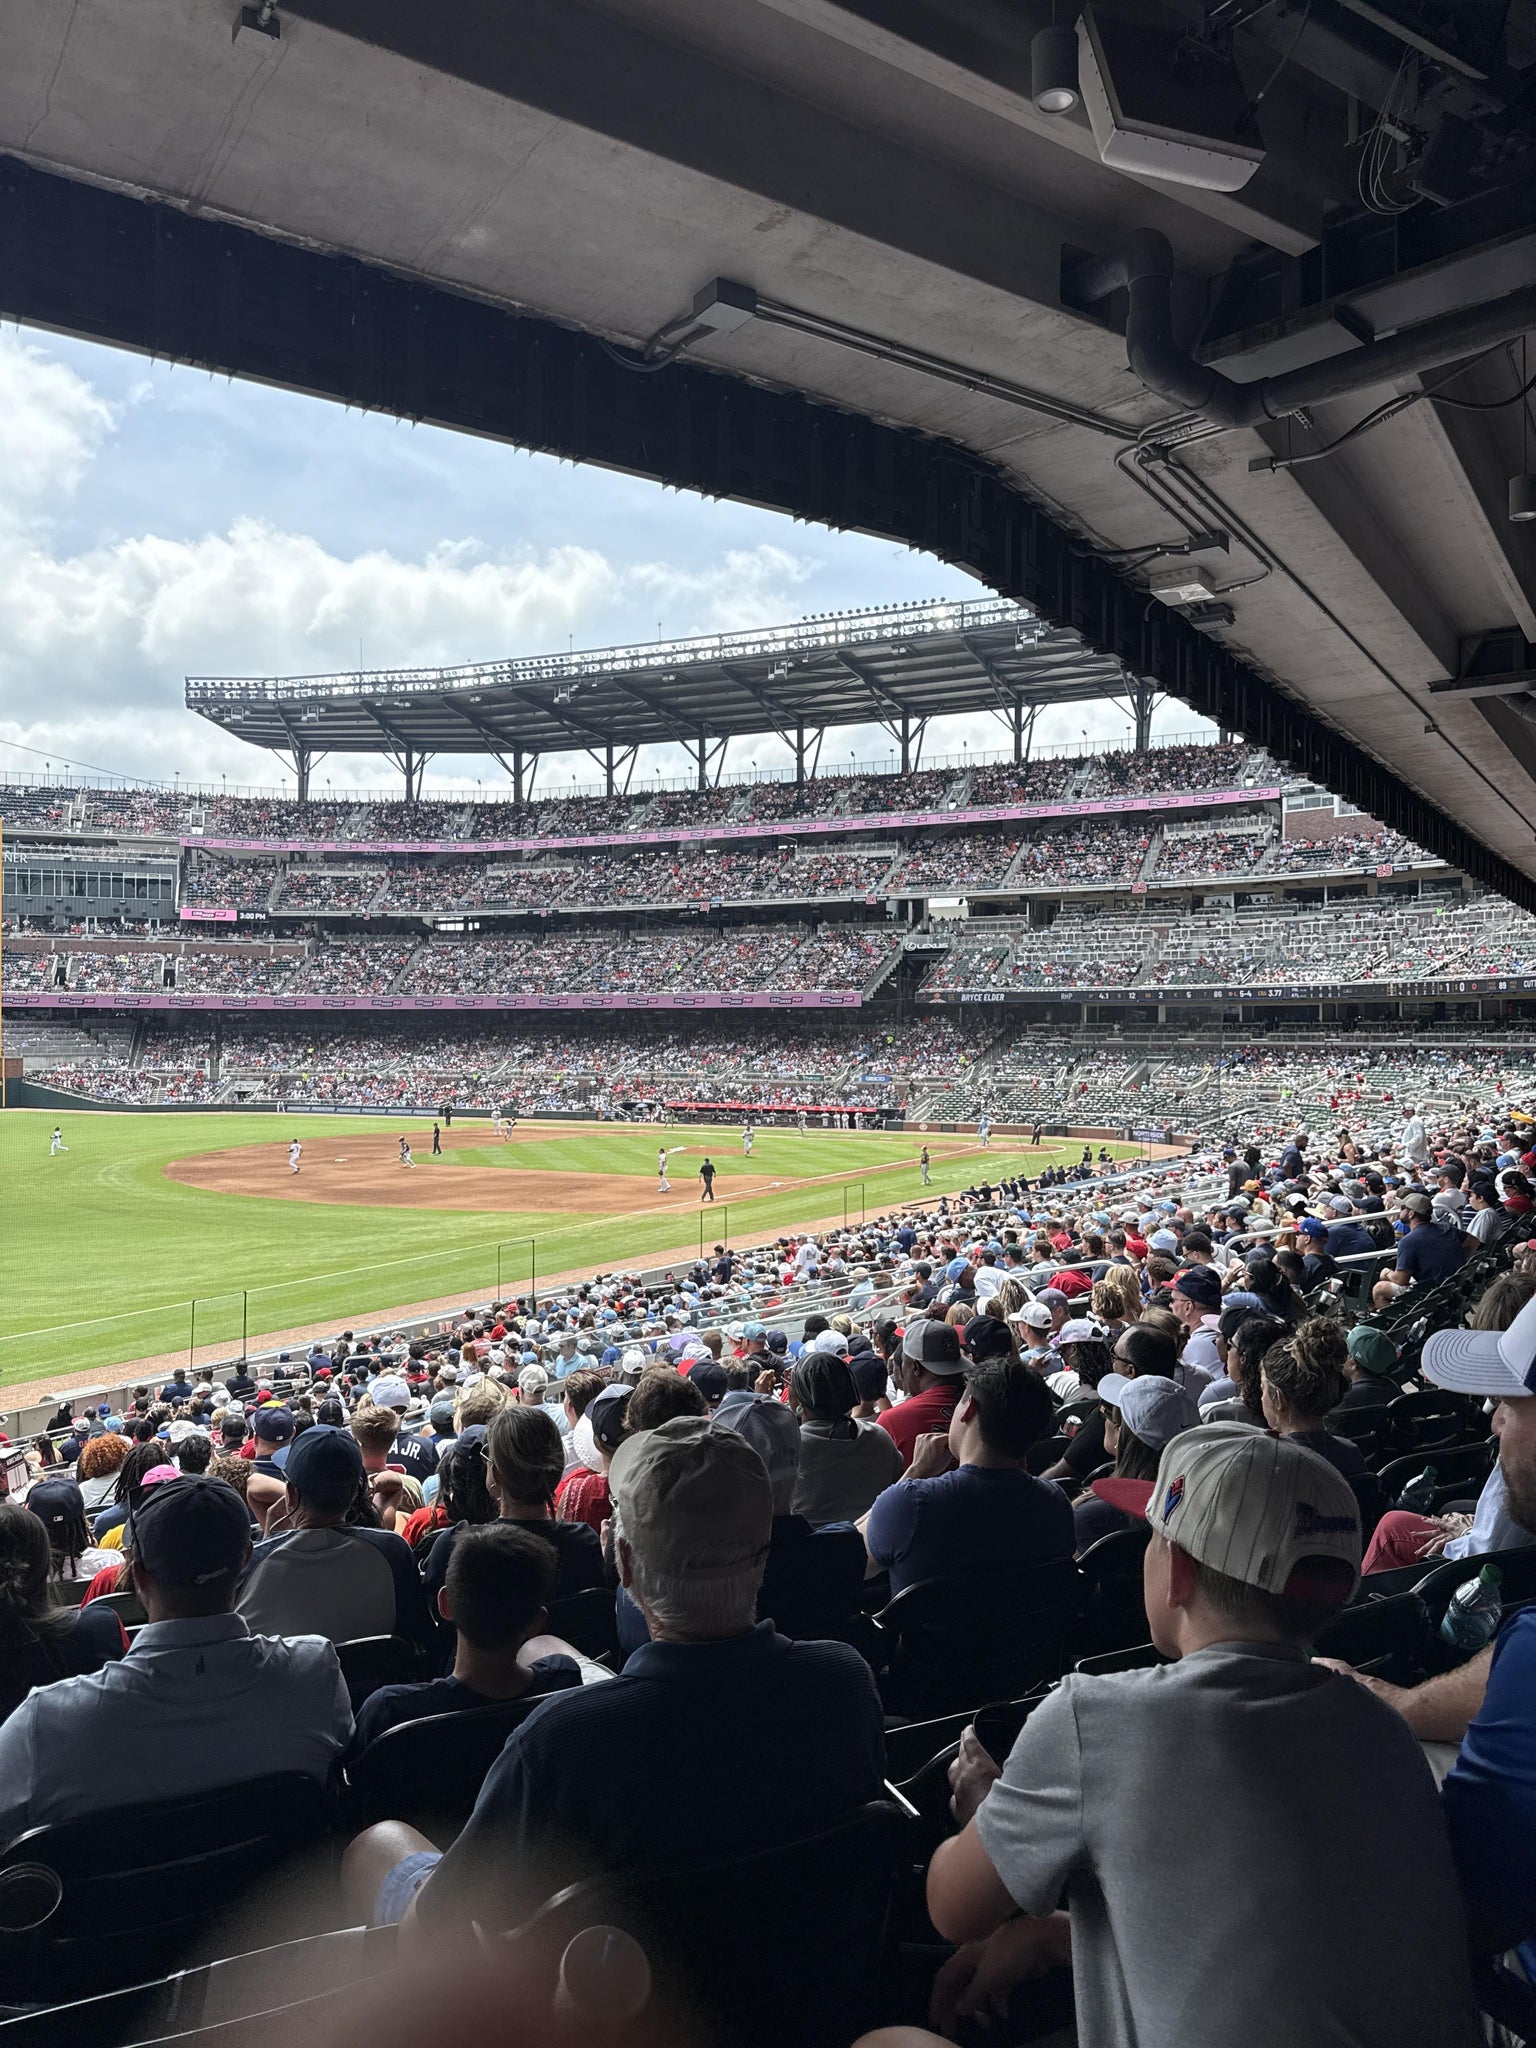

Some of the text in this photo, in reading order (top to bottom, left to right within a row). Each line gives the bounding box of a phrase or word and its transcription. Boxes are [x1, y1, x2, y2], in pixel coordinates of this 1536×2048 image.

[240, 912, 254, 920] 3:00
[961, 993, 983, 1001] BRYCE
[984, 993, 1005, 1001] ELDER
[1268, 989, 1282, 997] 3.77
[400, 1441, 421, 1460] JR.
